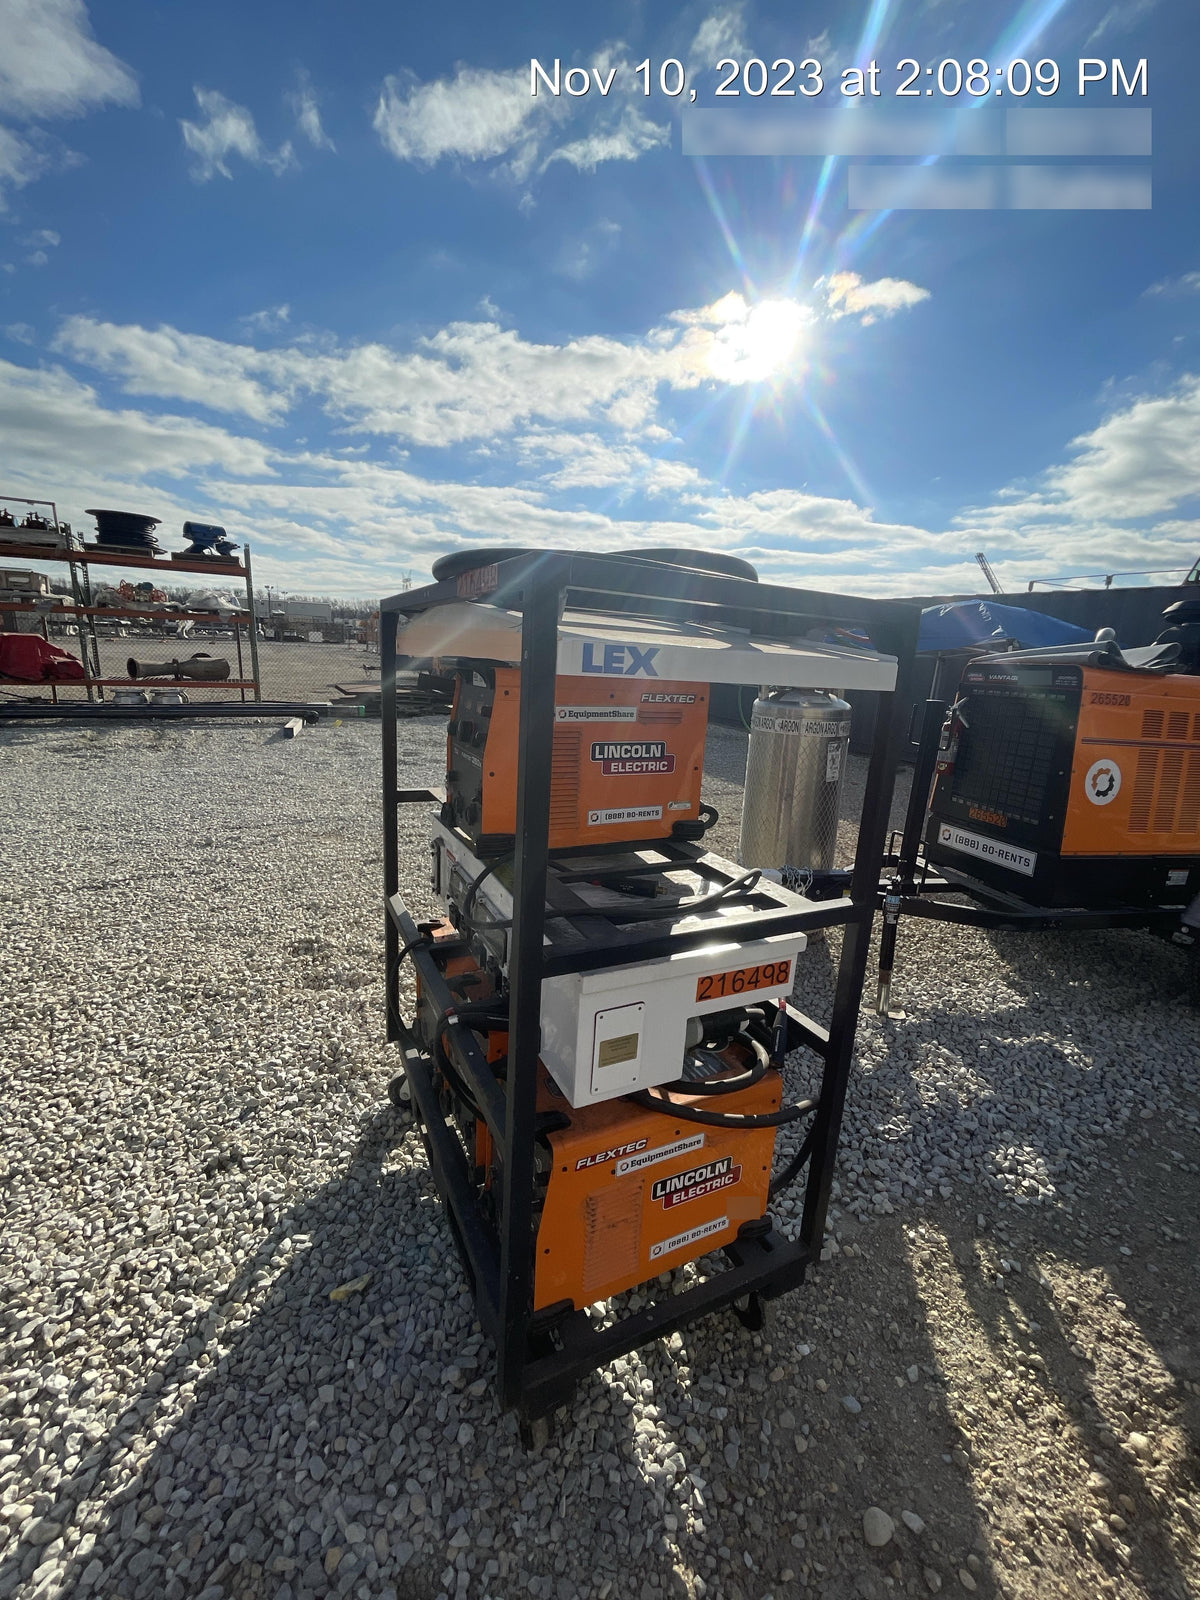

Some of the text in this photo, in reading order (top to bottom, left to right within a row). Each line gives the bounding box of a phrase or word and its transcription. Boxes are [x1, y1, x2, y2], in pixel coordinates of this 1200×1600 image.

[582, 643, 660, 677] LEX
[641, 694, 695, 703] FLEXTEC
[568, 710, 634, 719] EquipmentShare
[595, 745, 662, 759] LINCOLN
[611, 761, 668, 772] ELECTRIC
[955, 834, 1030, 867] (888) 80-RENTS
[699, 961, 789, 1000] 216498
[576, 1139, 647, 1170] FLEXTEC
[630, 1139, 702, 1168] EquipmentShare
[656, 1160, 728, 1197] LINCOLN
[672, 1174, 734, 1204] ELECTRIC
[691, 1219, 727, 1239] 80-RENTS
